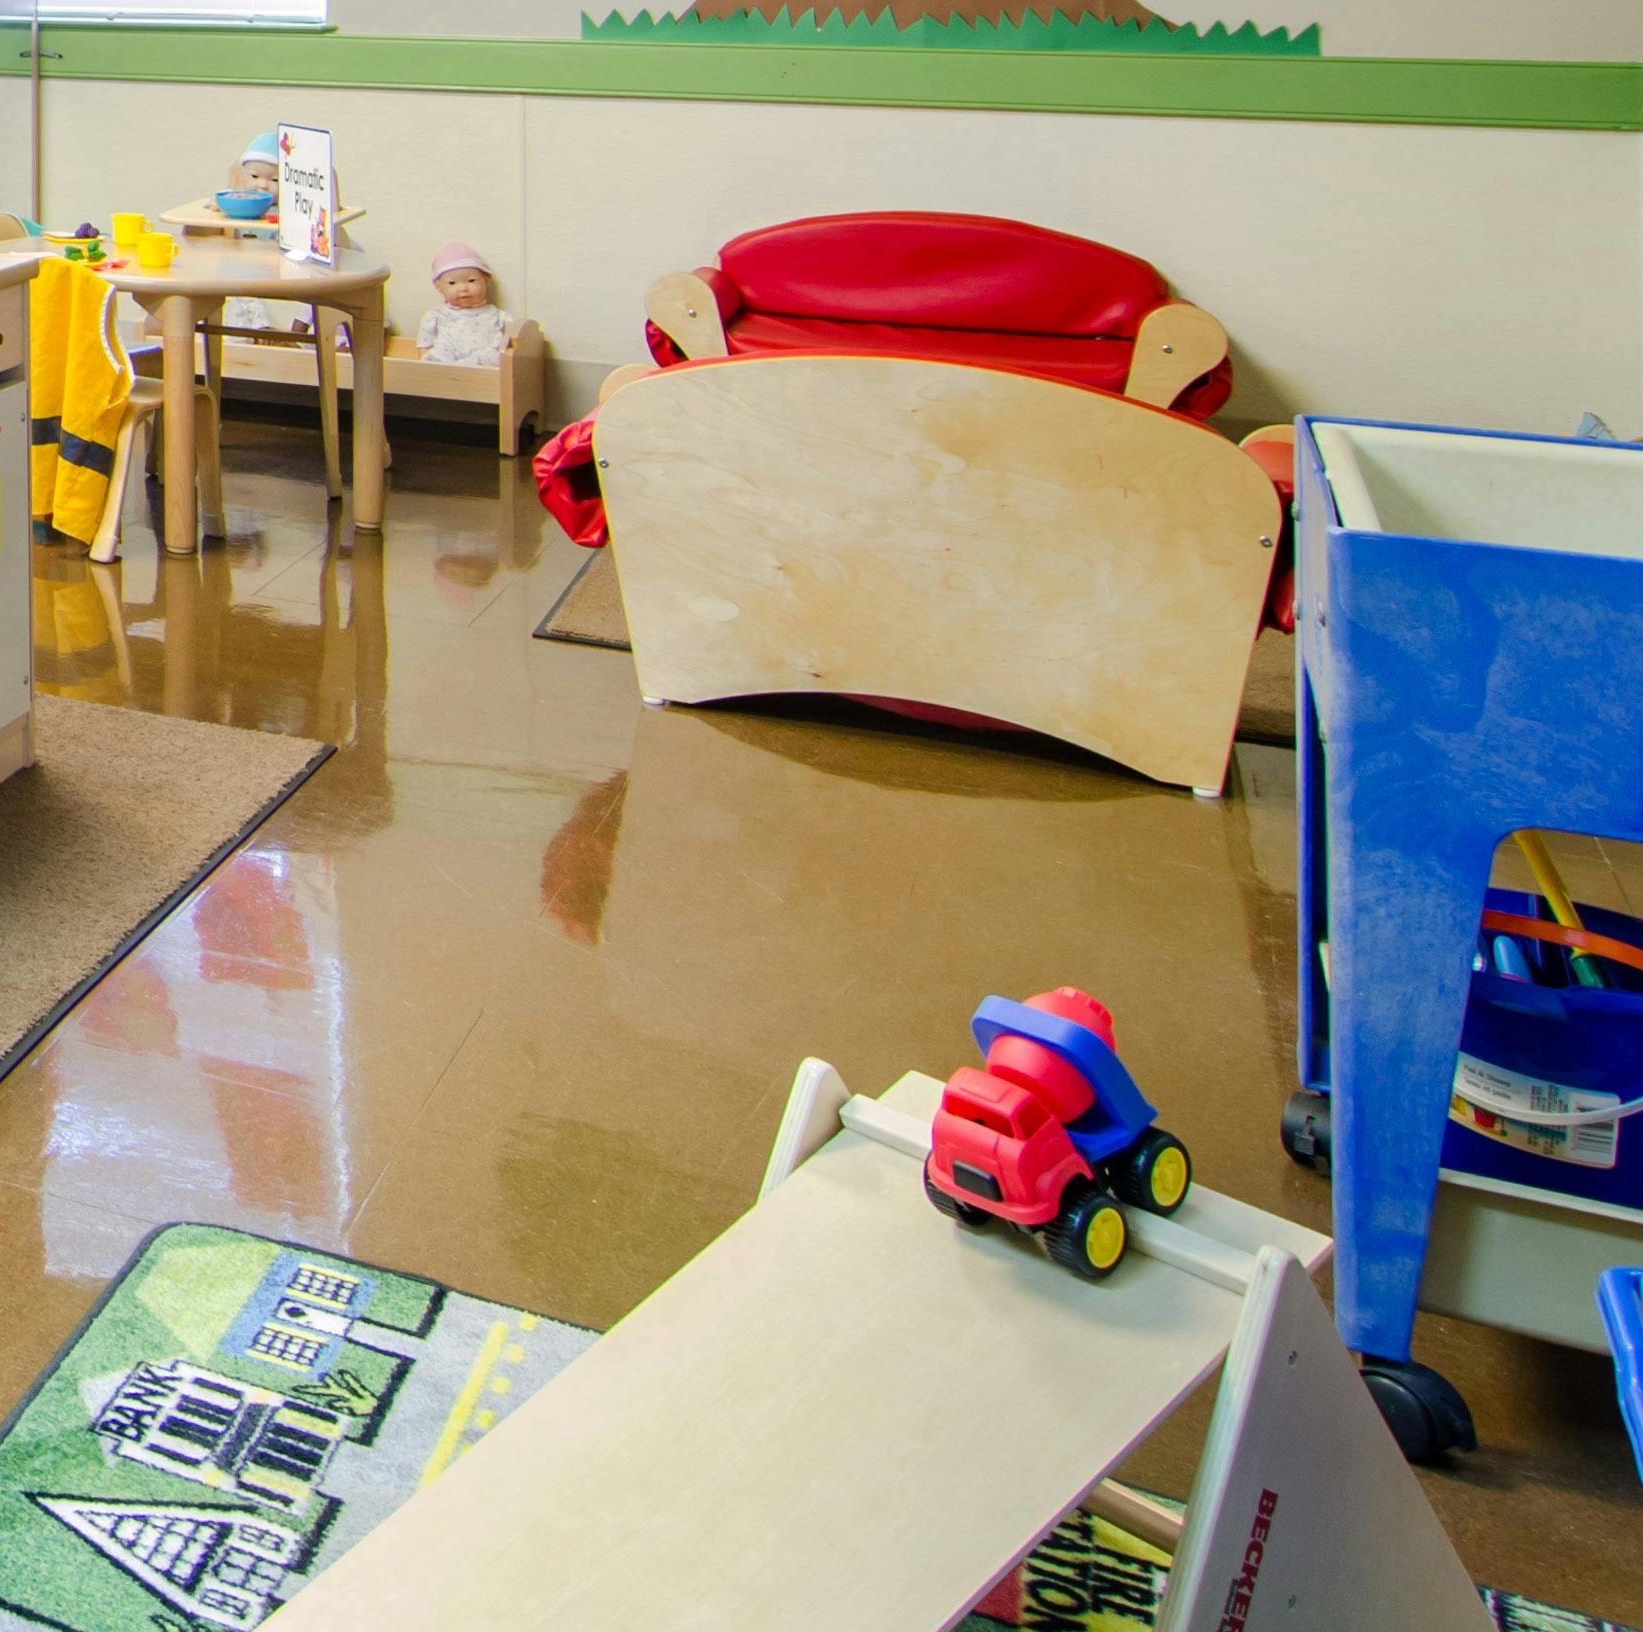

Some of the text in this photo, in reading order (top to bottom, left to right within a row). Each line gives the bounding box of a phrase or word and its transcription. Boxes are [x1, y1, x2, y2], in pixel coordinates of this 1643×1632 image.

[283, 162, 325, 191] Dramatic
[294, 191, 314, 221] Play
[100, 1366, 183, 1443] BANK
[1023, 1508, 1093, 1632] TATION
[1092, 1544, 1156, 1627] FIRE
